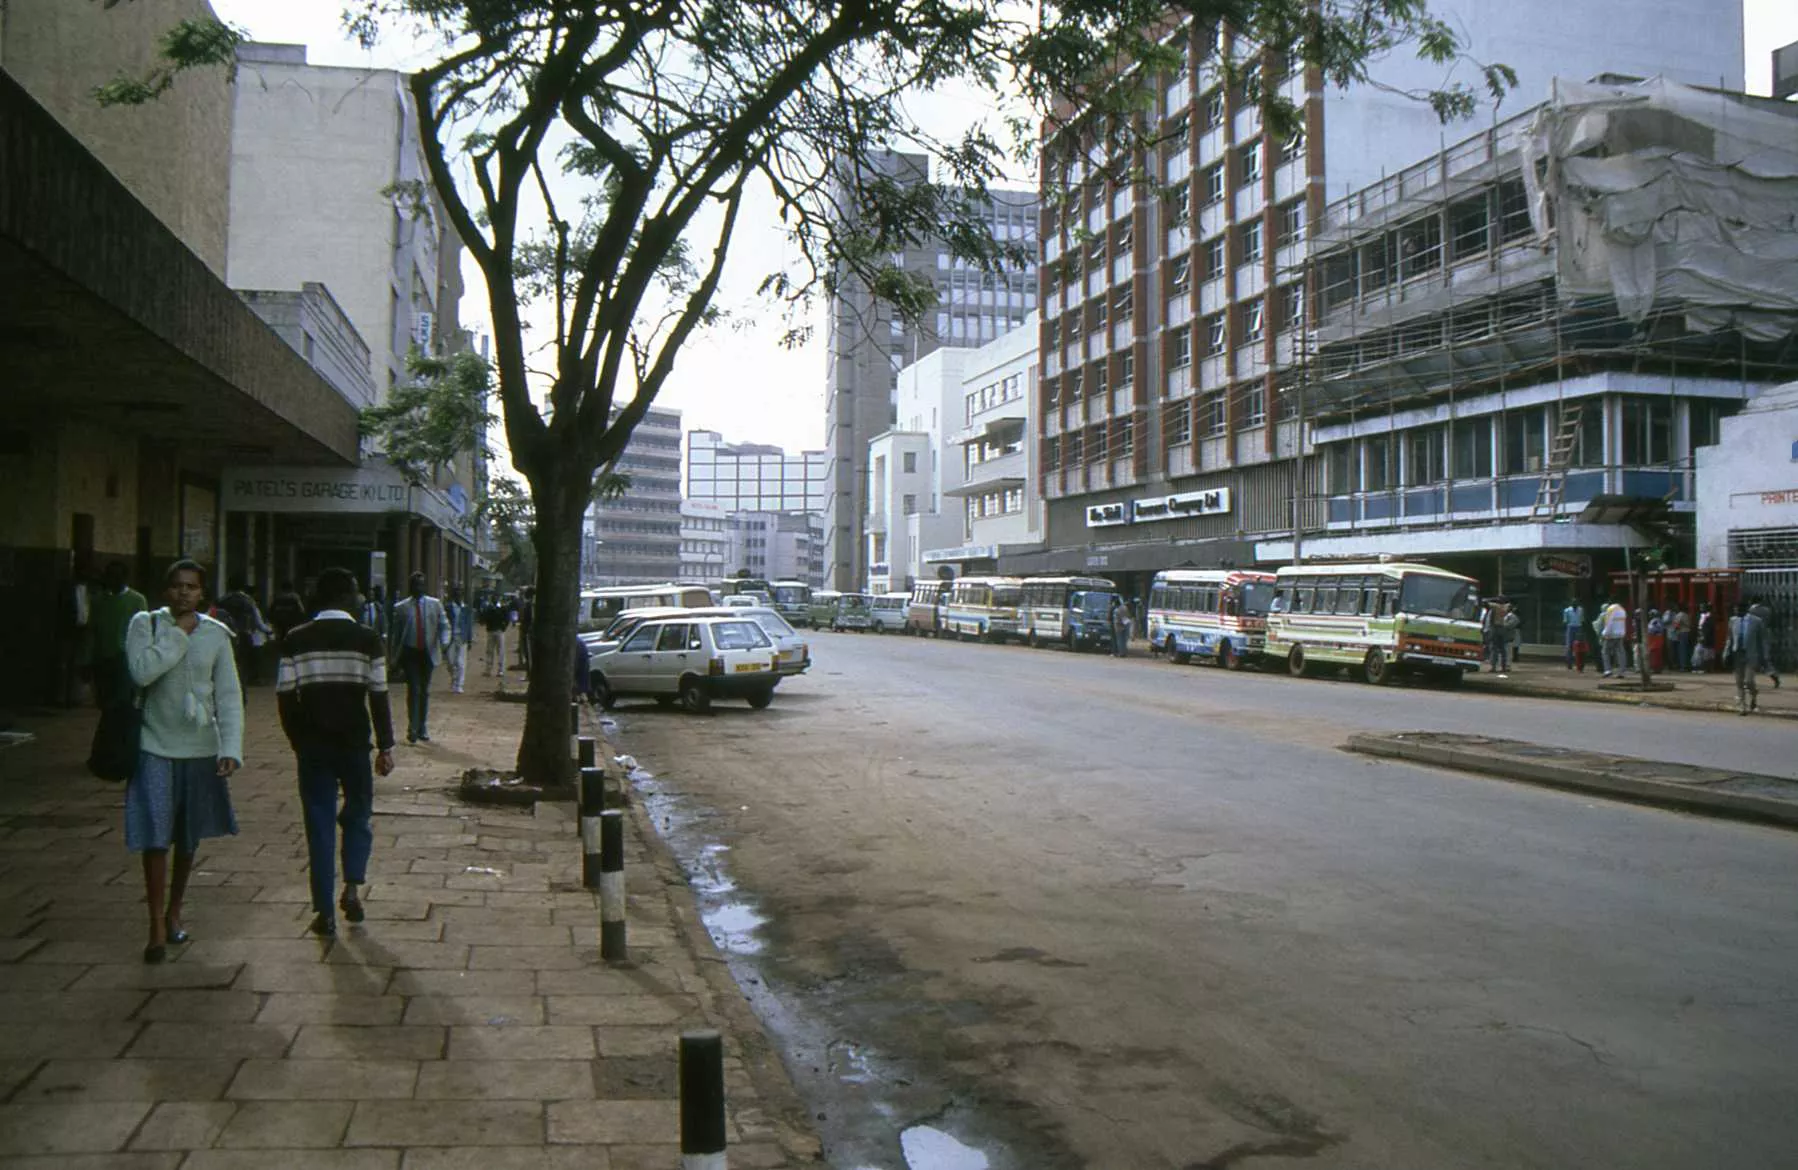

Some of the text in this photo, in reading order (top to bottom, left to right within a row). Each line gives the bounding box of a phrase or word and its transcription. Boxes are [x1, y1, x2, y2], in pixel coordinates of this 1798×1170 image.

[233, 479, 297, 498] PATEL'S
[302, 482, 358, 500] GARAGE
[377, 485, 403, 501] LTD
